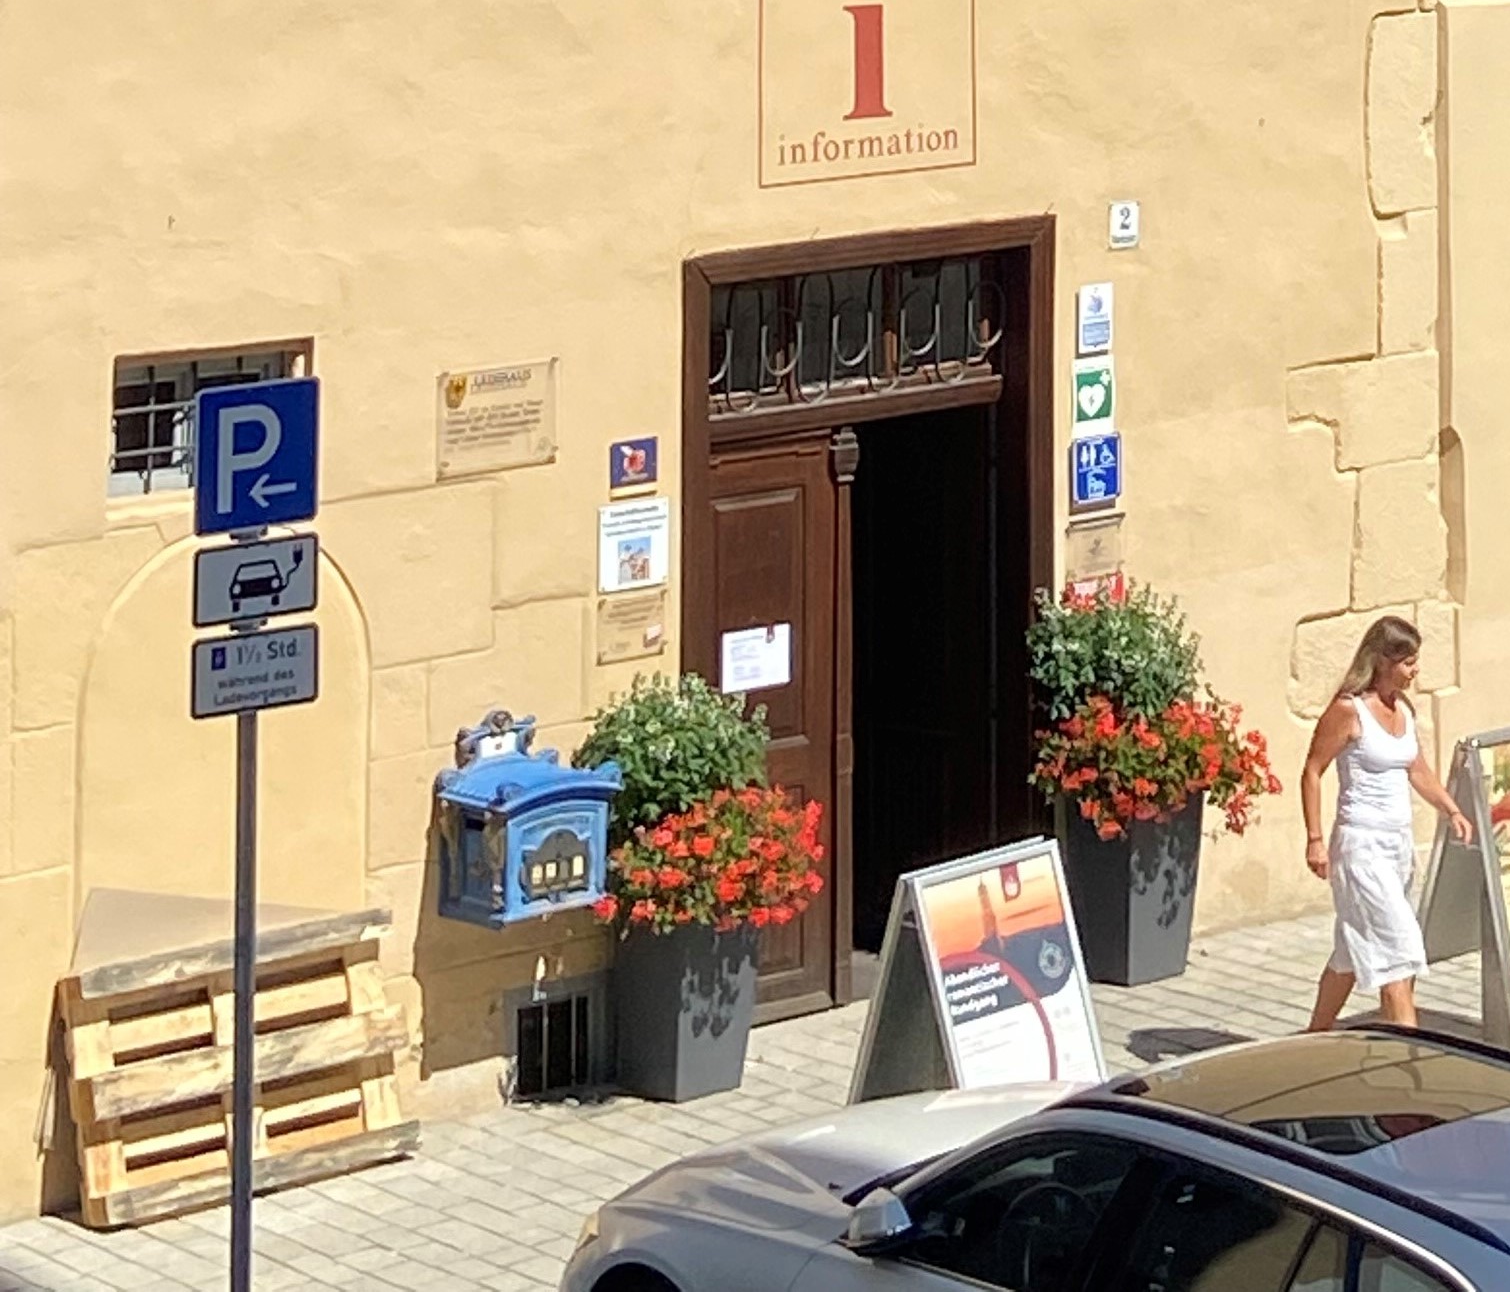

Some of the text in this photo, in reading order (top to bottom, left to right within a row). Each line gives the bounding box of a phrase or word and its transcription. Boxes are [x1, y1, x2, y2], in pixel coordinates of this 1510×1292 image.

[778, 123, 958, 165] information
[1119, 206, 1131, 230] 2
[217, 404, 281, 514] P
[274, 670, 295, 681] des
